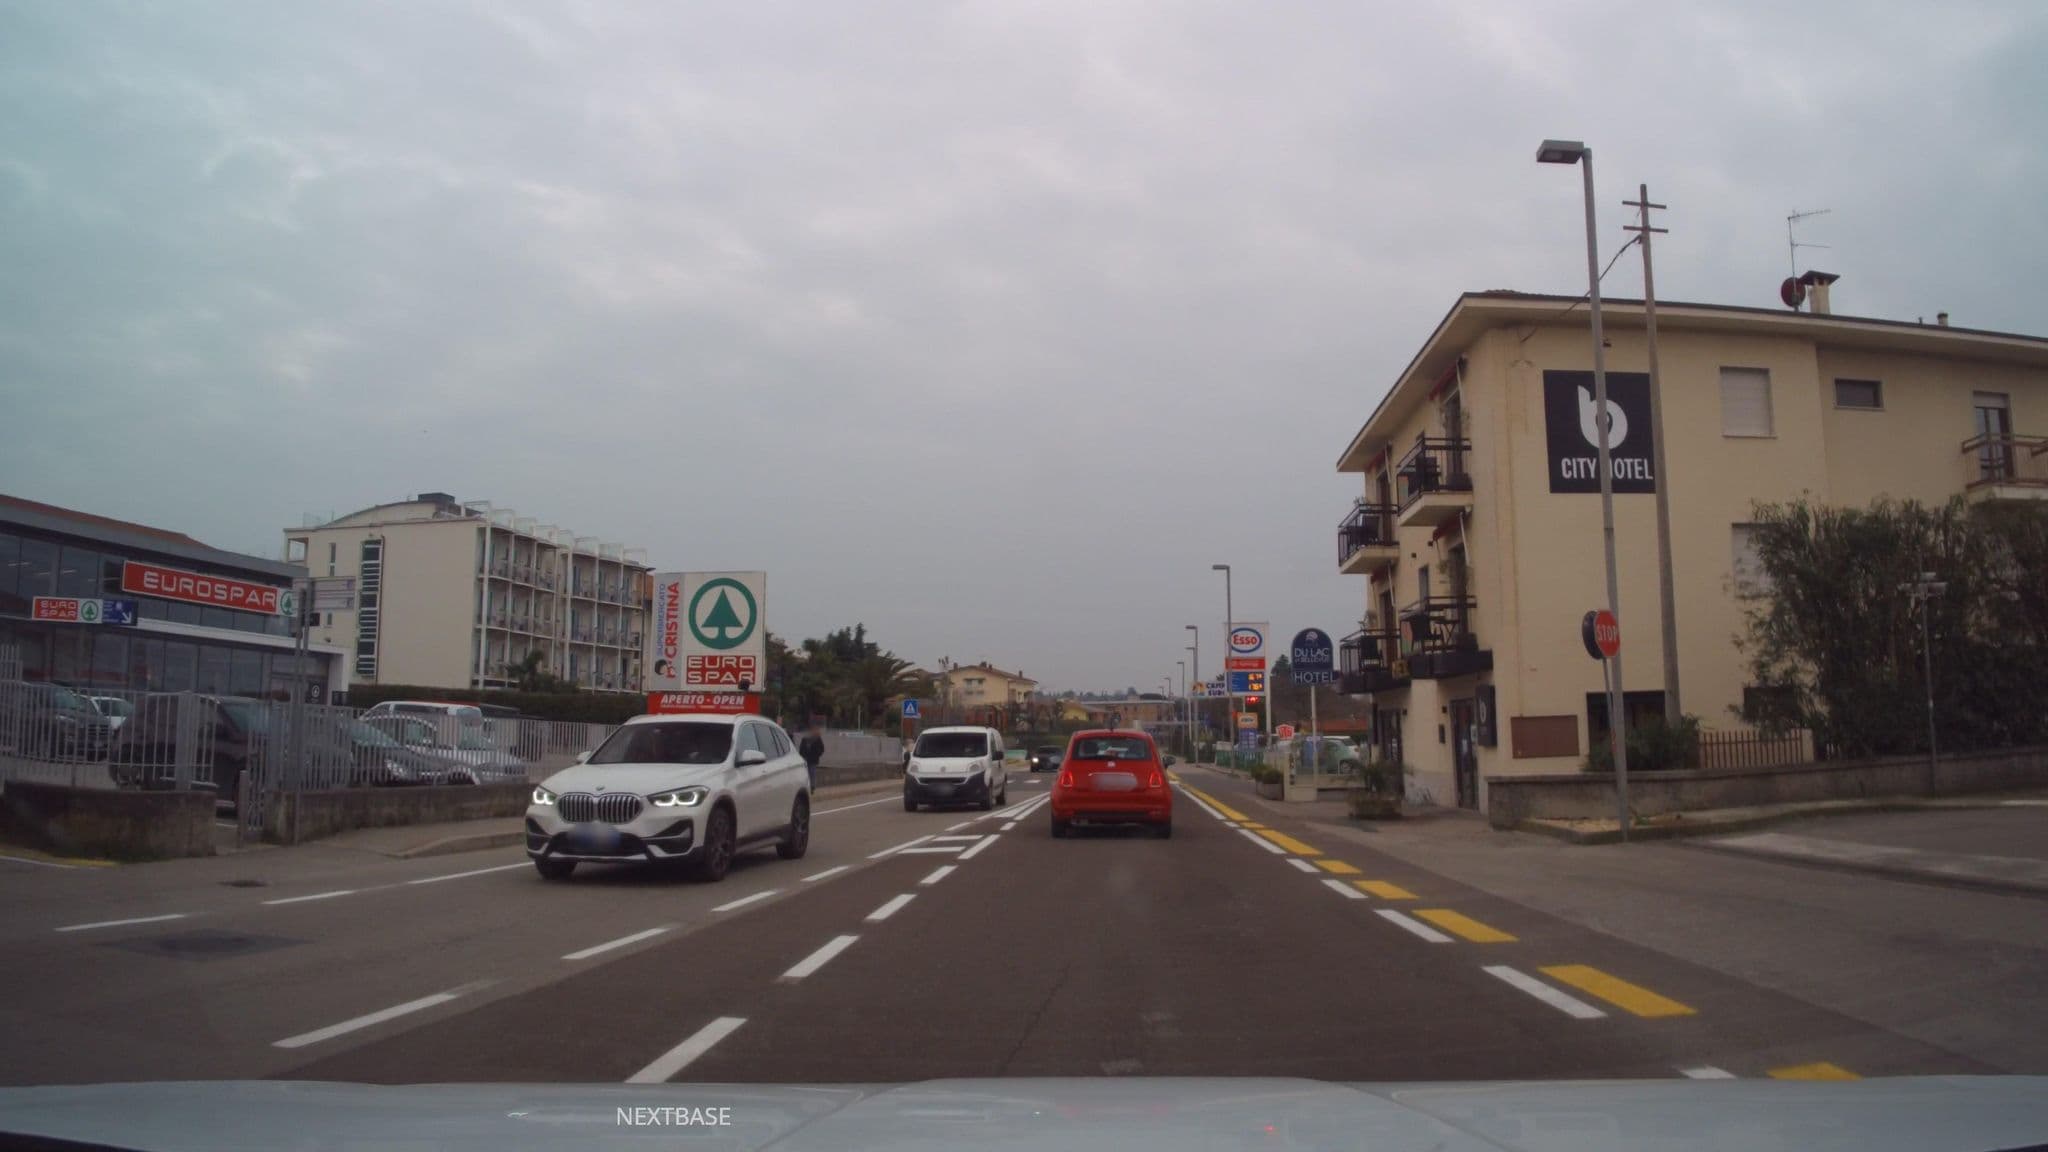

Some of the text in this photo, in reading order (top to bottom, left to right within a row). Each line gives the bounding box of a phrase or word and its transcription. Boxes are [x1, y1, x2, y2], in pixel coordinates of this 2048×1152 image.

[1561, 458, 1597, 480] CITY
[143, 571, 276, 607] EUROSPAR
[40, 600, 77, 609] EURO
[40, 609, 77, 619] SPAR
[664, 581, 680, 659] CRISTINA
[1233, 635, 1258, 645] Esso
[1596, 624, 1618, 644] STOP
[1294, 647, 1329, 657] DU LAC
[688, 656, 755, 669] EURO
[688, 671, 755, 683] SPAR
[1294, 671, 1337, 683] HOTEL
[660, 694, 705, 705] APERTO
[712, 695, 745, 705] OPEN
